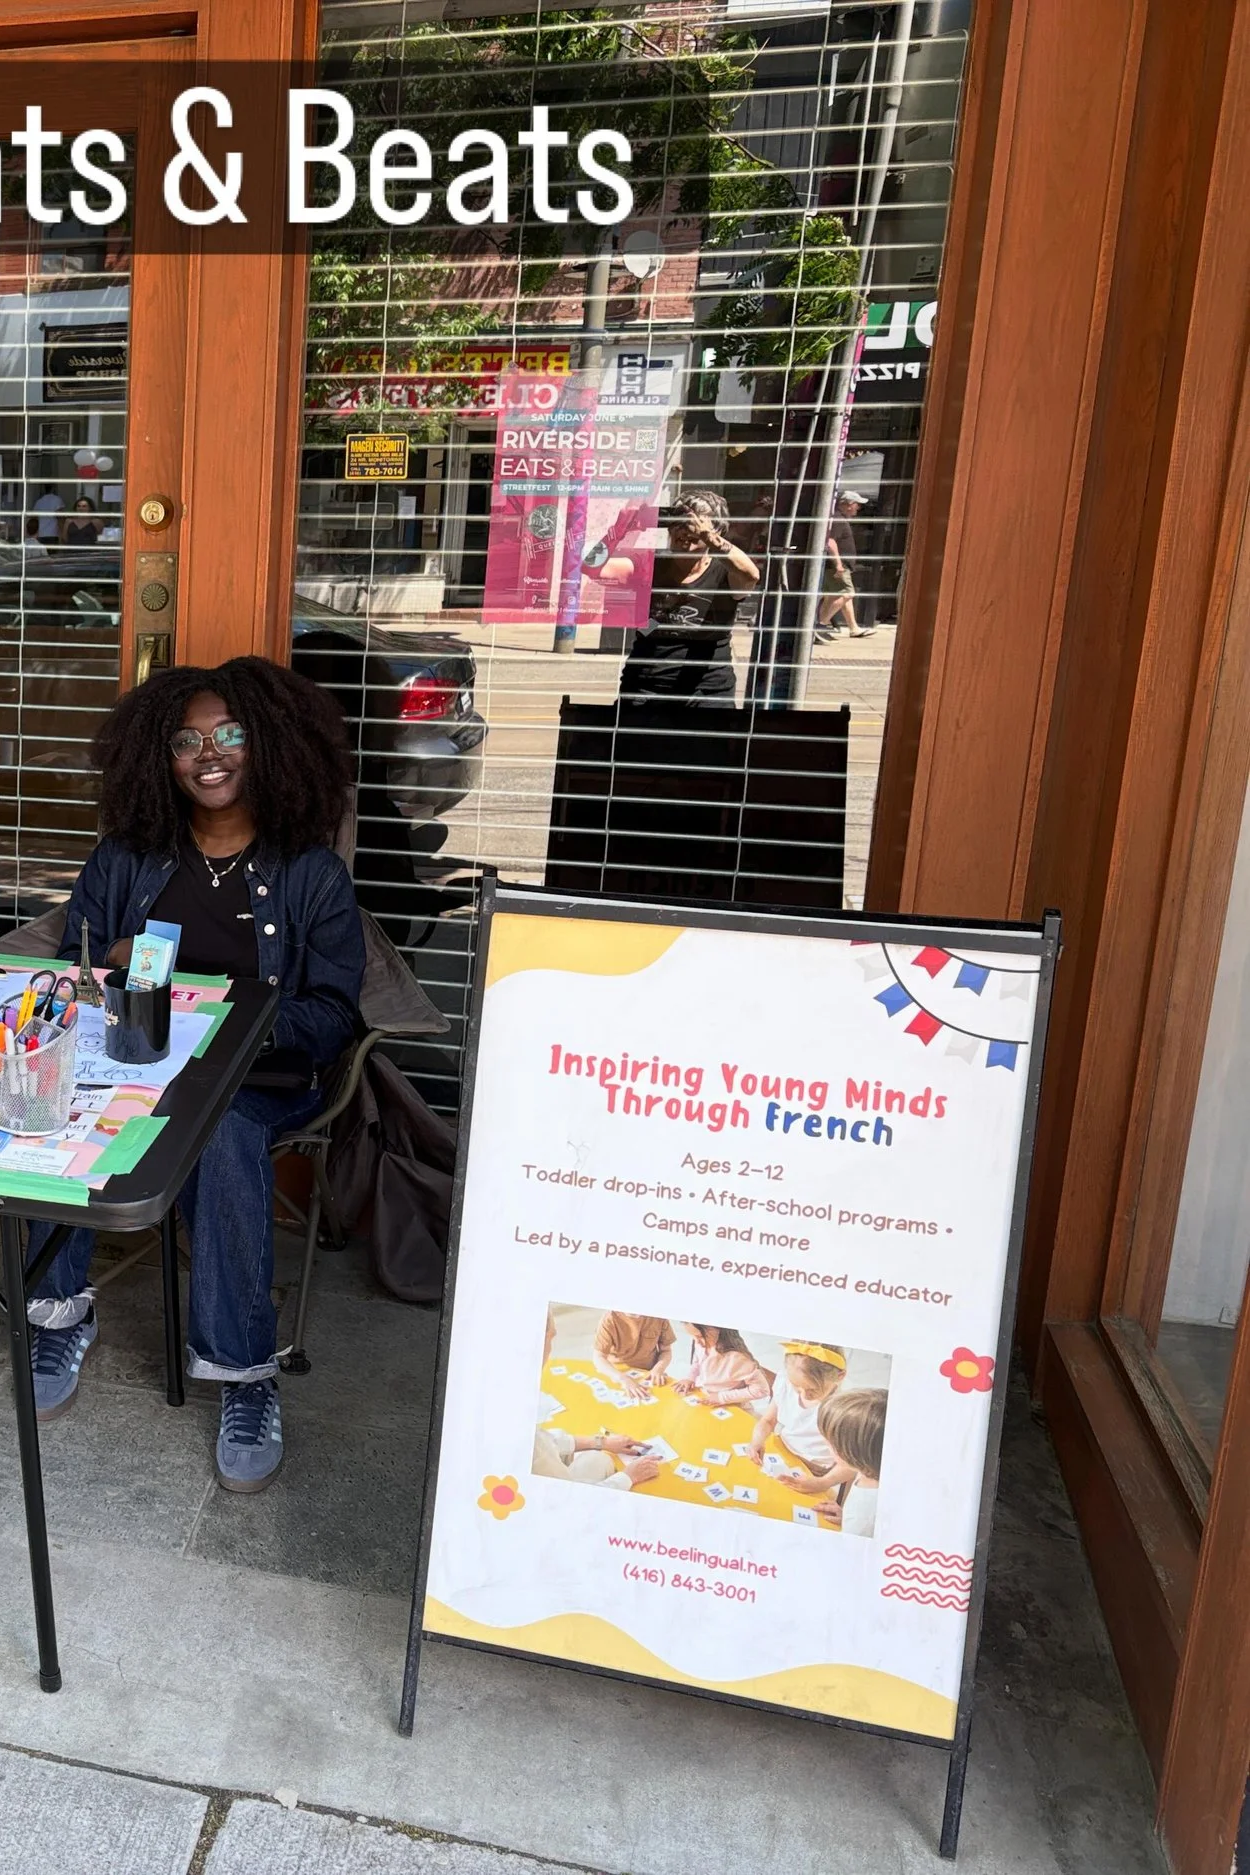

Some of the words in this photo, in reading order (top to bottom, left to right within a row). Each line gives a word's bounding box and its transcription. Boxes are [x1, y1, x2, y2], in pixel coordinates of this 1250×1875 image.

[531, 413, 586, 422] SATURDAY
[588, 414, 616, 422] JUNE
[374, 440, 405, 452] SECURITY
[502, 430, 631, 450] RIVERSIDE
[364, 467, 403, 476] 783-7014
[500, 458, 555, 476] EATS
[561, 459, 576, 477] &
[582, 459, 656, 478] BEATS
[502, 484, 551, 492] STREETFEST
[624, 485, 650, 493] SHINE
[170, 990, 201, 1001] ET
[548, 1044, 704, 1096] Inspiring
[721, 1063, 829, 1111] Young
[846, 1077, 948, 1119] Minds
[603, 1083, 750, 1132] Through
[765, 1101, 894, 1147] French
[680, 1152, 731, 1174] Ages
[521, 1164, 597, 1189] Toddler
[603, 1176, 682, 1199] drop-ins
[701, 1188, 832, 1221] After-school
[838, 1209, 938, 1236] programs
[643, 1212, 709, 1237] Camps
[715, 1226, 753, 1242] and
[759, 1231, 810, 1251] more
[515, 1226, 553, 1247] Led
[559, 1232, 582, 1254] by
[588, 1241, 600, 1253] a
[605, 1242, 714, 1273] passionate,
[720, 1259, 848, 1290] experienced
[854, 1278, 952, 1306] educator
[608, 1535, 778, 1578] www.beelingual.net
[623, 1563, 666, 1587] (416)
[671, 1573, 756, 1603] 843-3001
